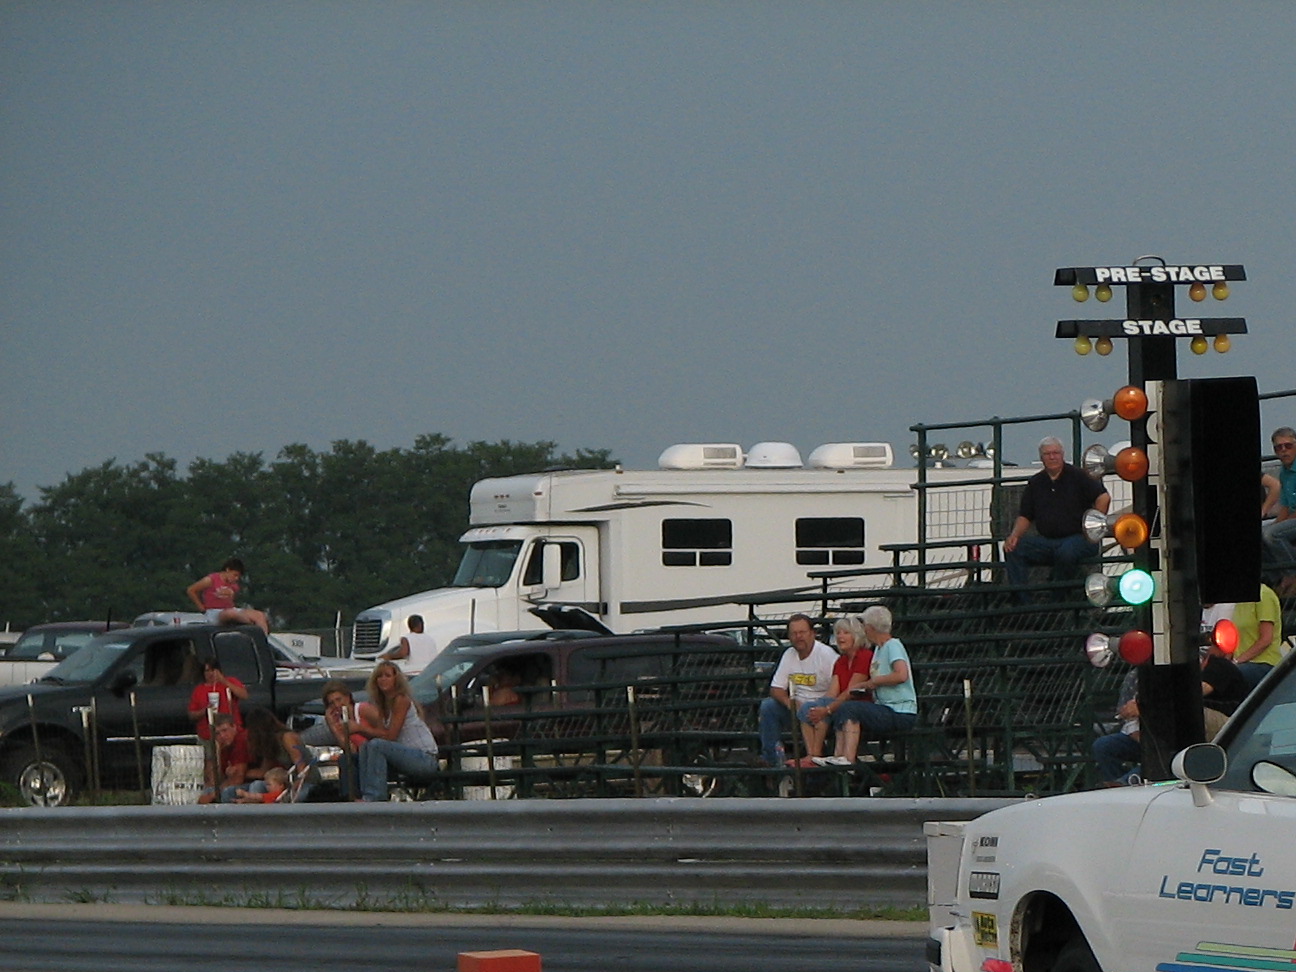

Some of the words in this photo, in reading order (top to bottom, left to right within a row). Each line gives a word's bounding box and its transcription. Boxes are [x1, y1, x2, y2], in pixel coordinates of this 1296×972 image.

[1095, 266, 1226, 283] PRE-STAGE
[1122, 319, 1204, 335] STAGE
[1197, 848, 1264, 878] Fast
[1158, 875, 1296, 910] Learners
